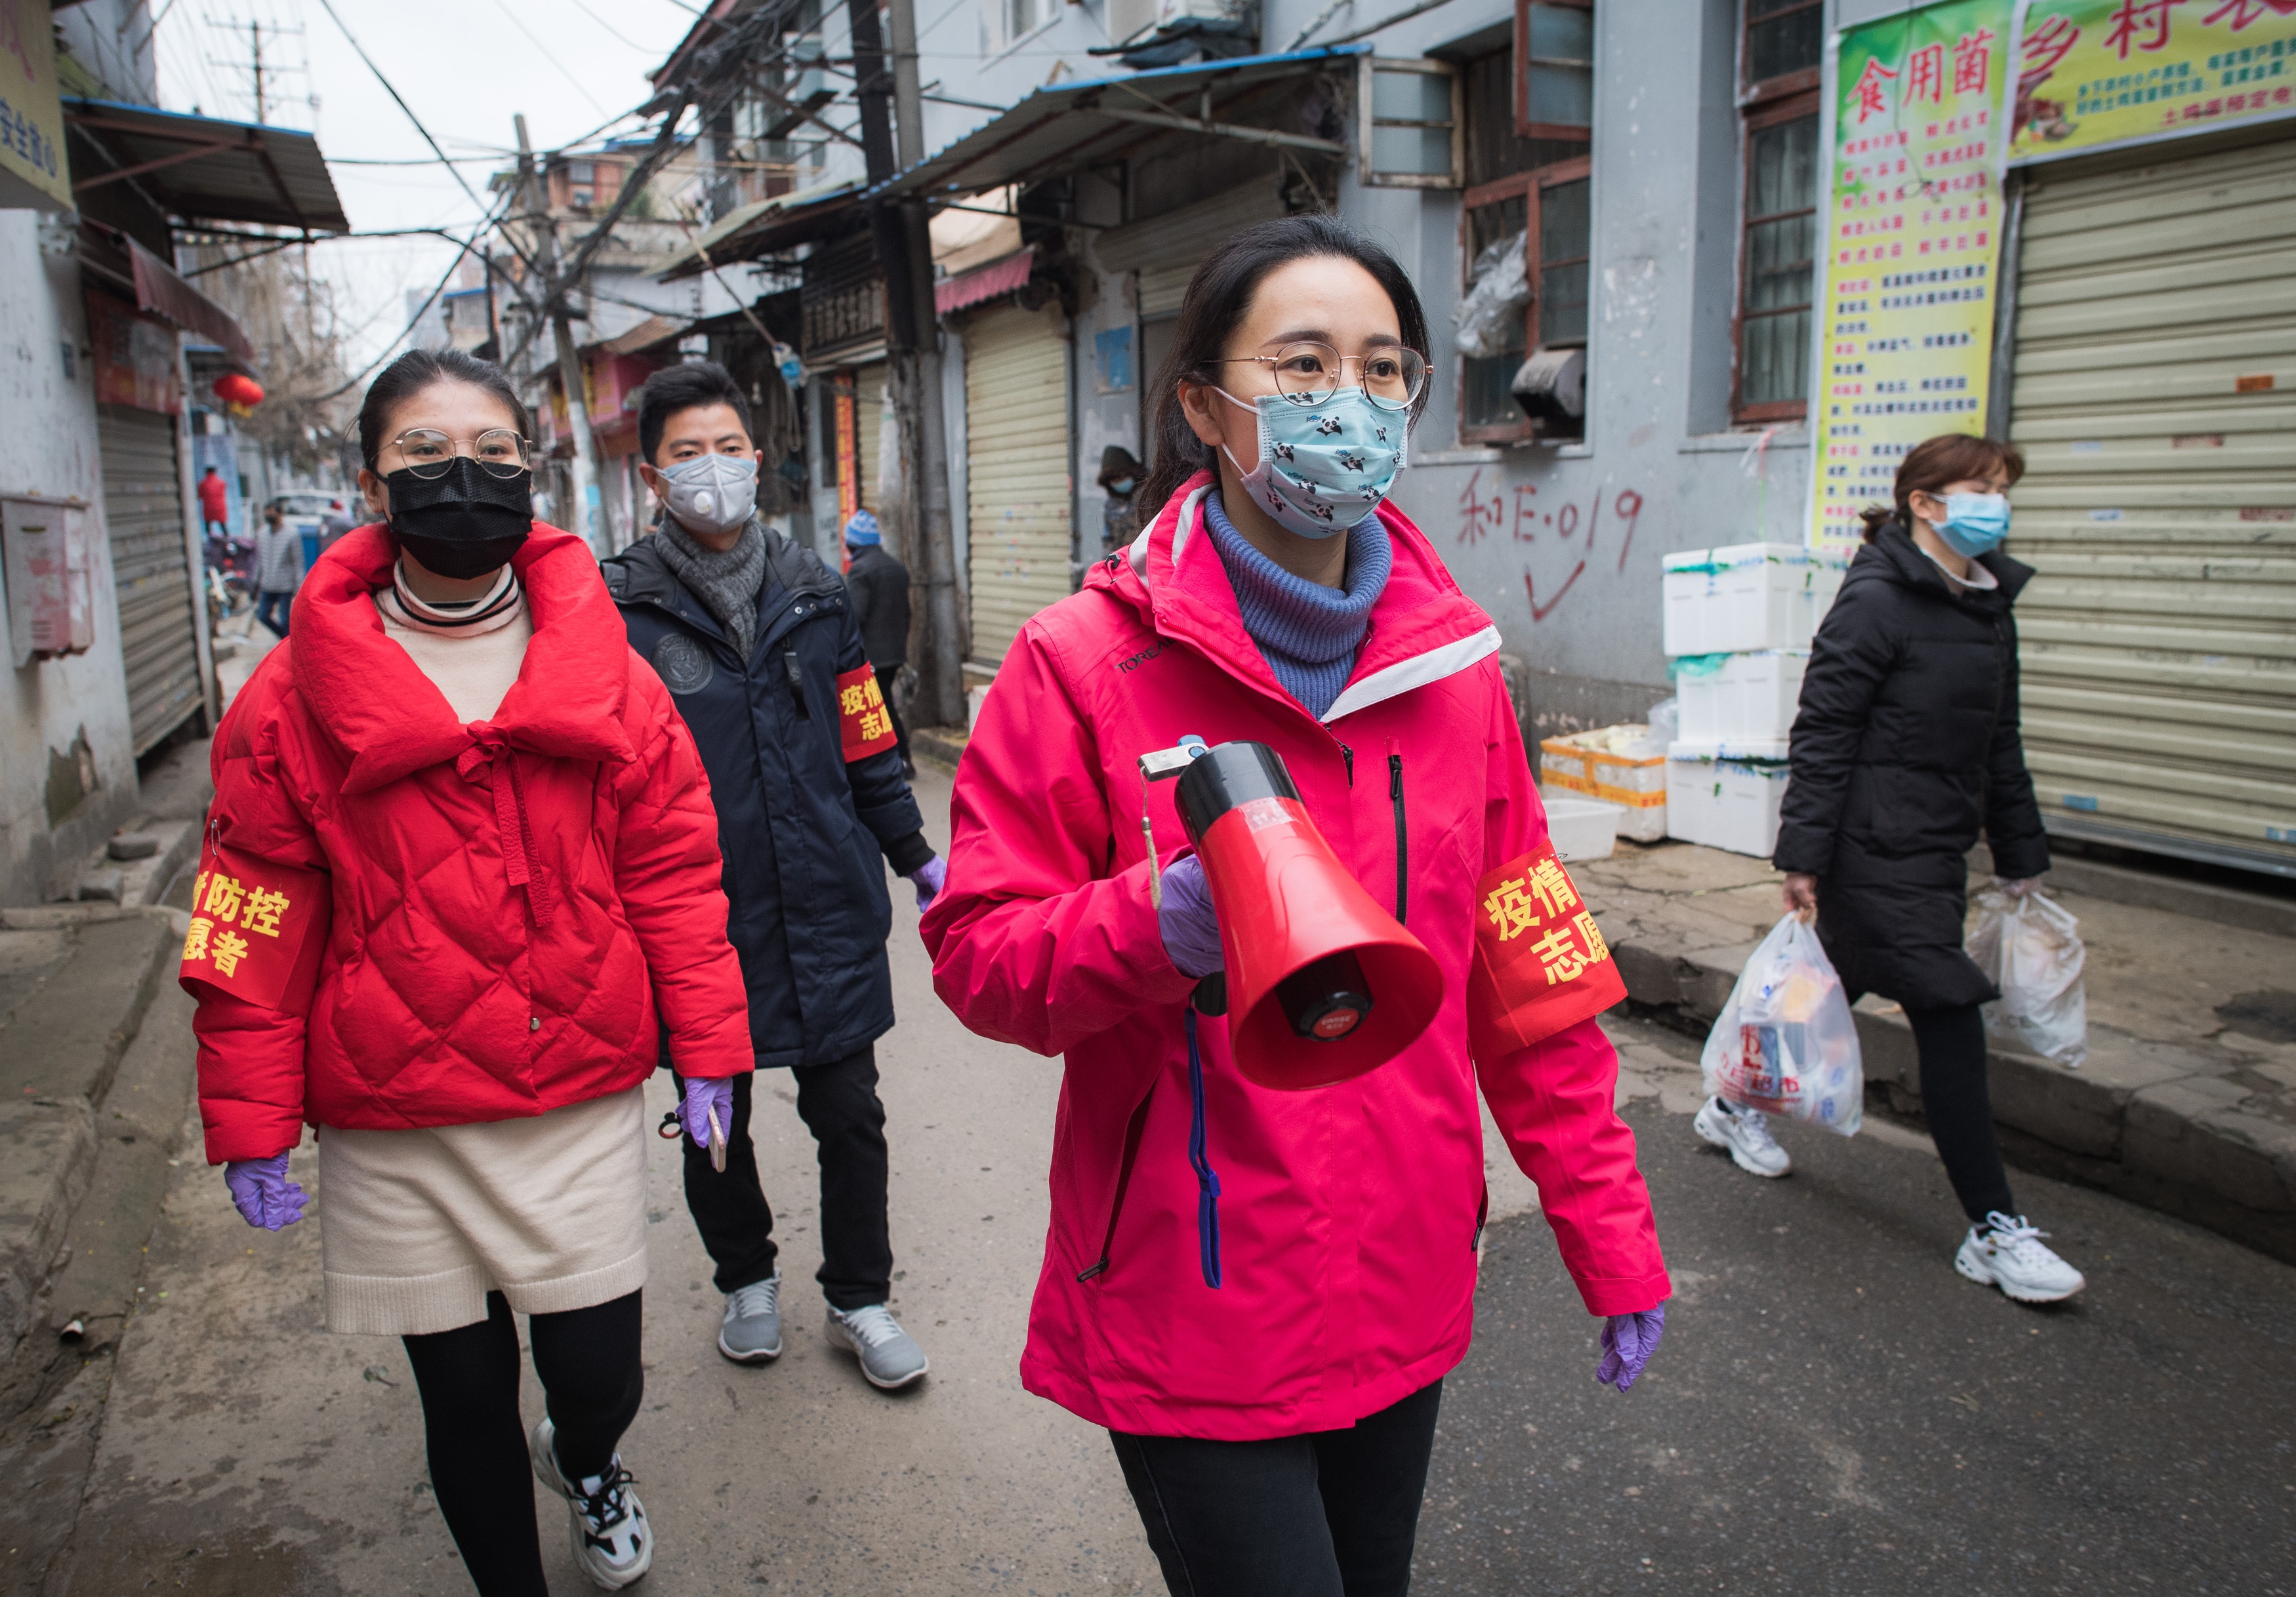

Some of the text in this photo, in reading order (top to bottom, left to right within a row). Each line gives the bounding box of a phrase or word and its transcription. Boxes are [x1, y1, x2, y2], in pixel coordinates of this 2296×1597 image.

[1848, 29, 1996, 123] 食用菌
[840, 676, 883, 716] 疫情
[1483, 858, 1578, 942] 疫情
[183, 916, 249, 979] 愿者
[1530, 910, 1610, 986] 志愿
